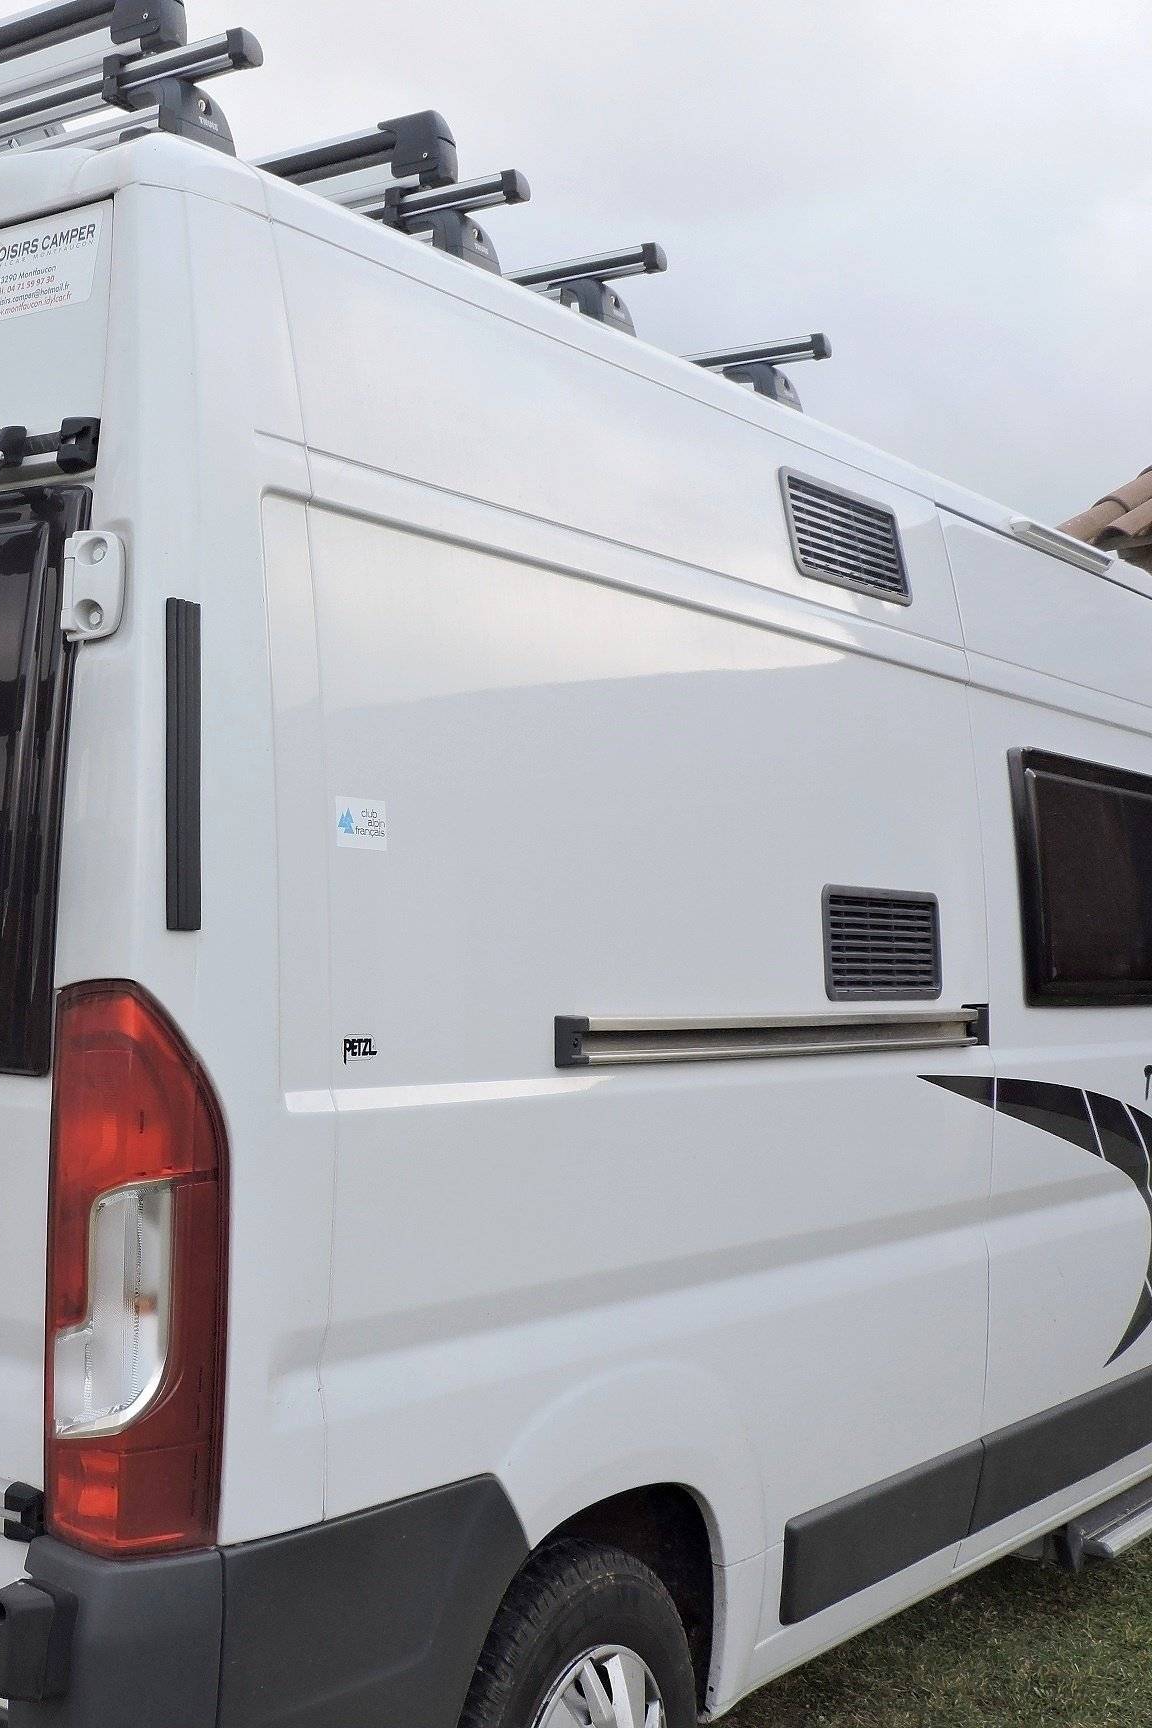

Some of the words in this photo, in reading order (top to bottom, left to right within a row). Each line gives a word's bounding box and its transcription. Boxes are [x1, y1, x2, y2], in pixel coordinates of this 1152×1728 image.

[41, 223, 96, 250] CAMPER
[19, 265, 57, 280] Montfaucon
[7, 285, 16, 293] 04
[360, 808, 378, 819] club
[355, 825, 386, 838] français
[343, 1038, 378, 1065] PETZL
